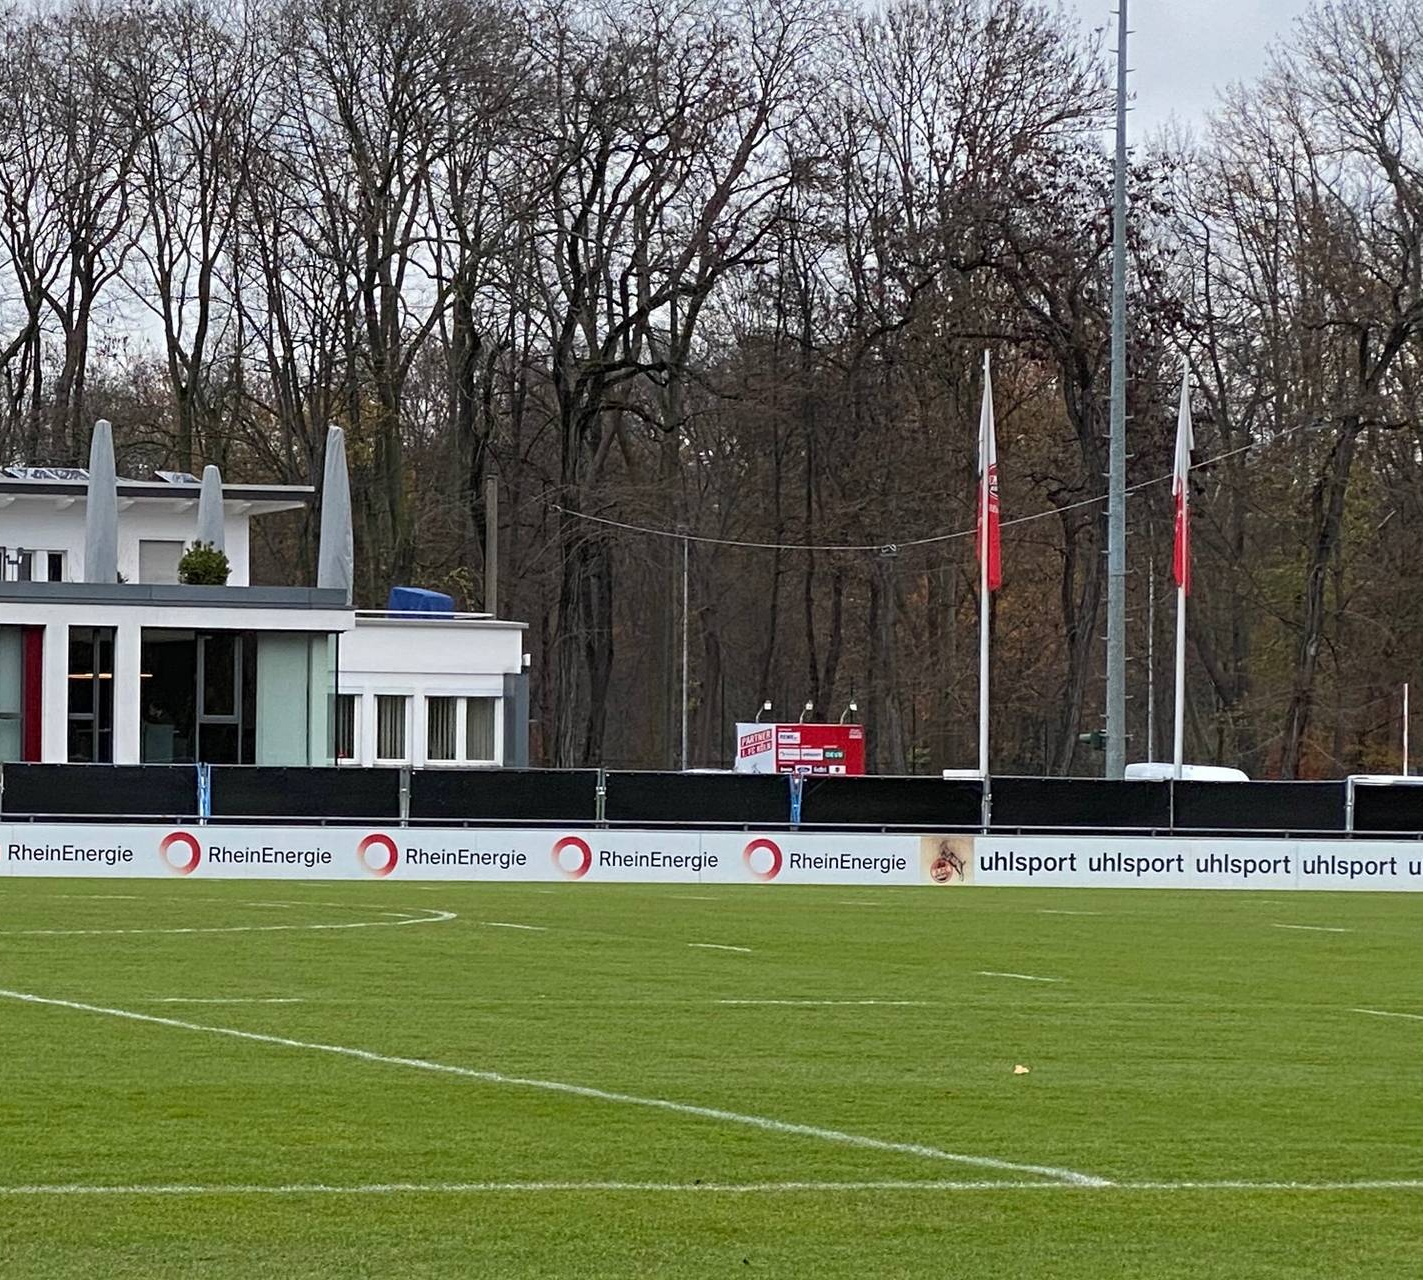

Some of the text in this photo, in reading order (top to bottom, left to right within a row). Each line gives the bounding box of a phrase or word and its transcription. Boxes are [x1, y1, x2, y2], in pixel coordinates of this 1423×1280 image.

[741, 730, 771, 746] PARTNER
[8, 844, 134, 865] RheinEnergie
[208, 847, 332, 867] RheinEnergie
[405, 848, 527, 870] RheinEnergie
[599, 851, 719, 872] RheinEnergie
[789, 853, 907, 873] RheinEnergie
[980, 851, 1077, 876] uhlsport
[1088, 852, 1184, 877] uhlsport
[1196, 854, 1291, 878] uhlsport
[1303, 855, 1398, 879] uhlsport
